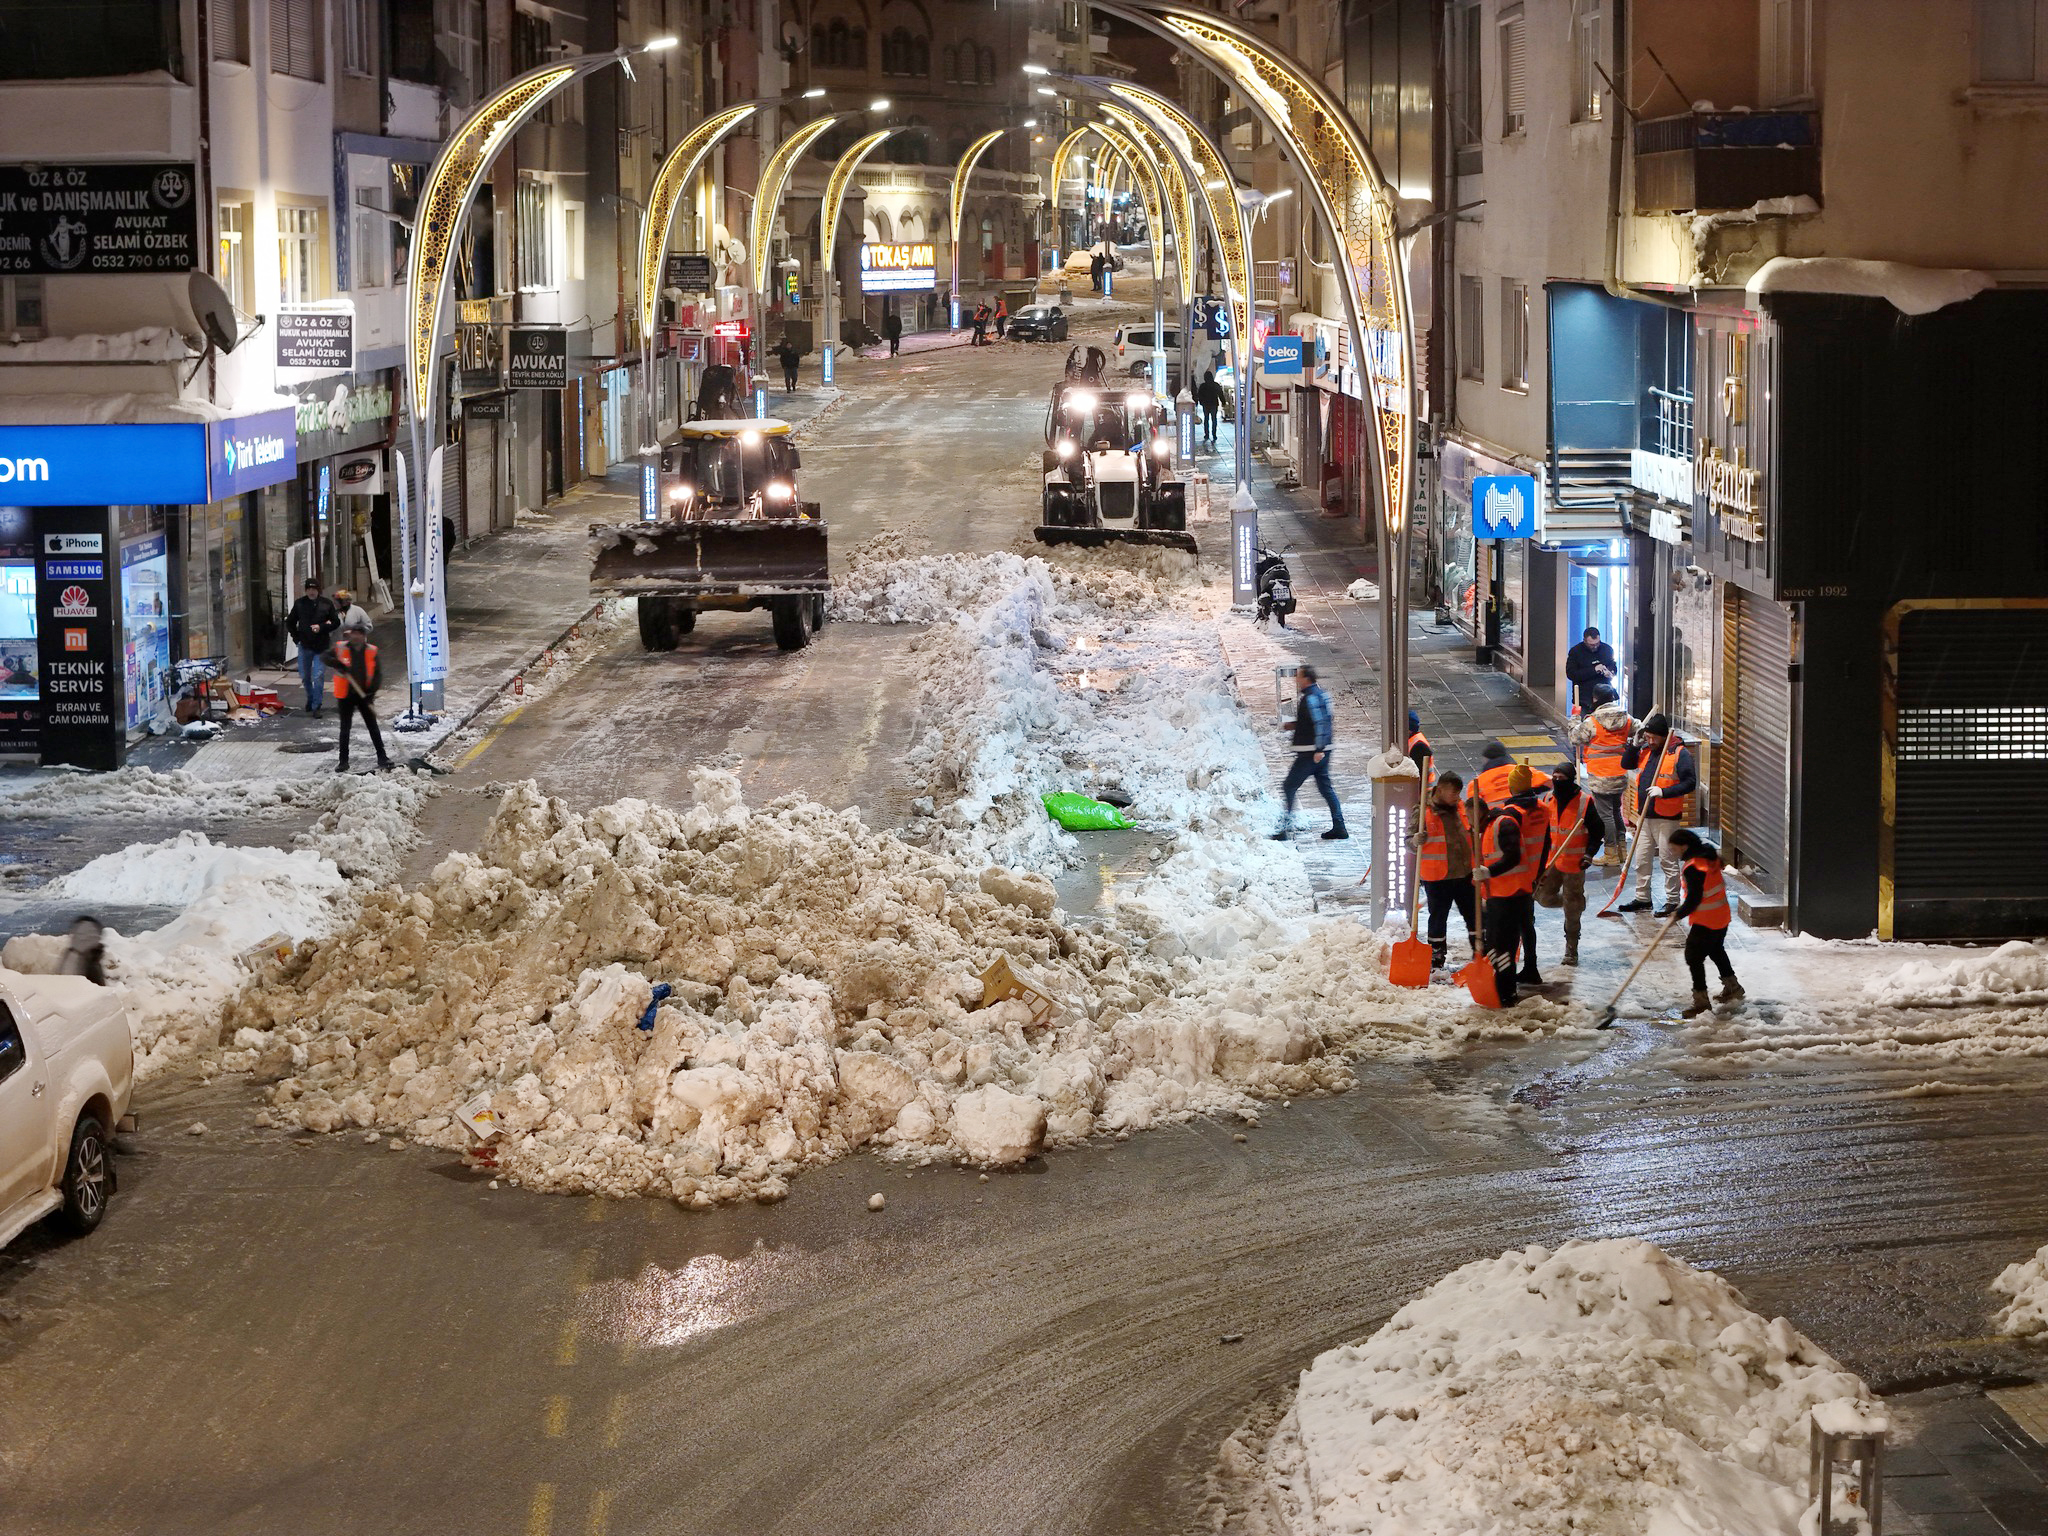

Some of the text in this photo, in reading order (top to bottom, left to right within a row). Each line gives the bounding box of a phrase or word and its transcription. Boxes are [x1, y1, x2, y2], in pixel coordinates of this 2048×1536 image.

[53, 172, 64, 187] &
[67, 168, 87, 187] ÖZ
[21, 196, 37, 212] ve
[43, 189, 150, 217] DANIŞMANLIK
[115, 216, 168, 229] AVUKAT
[0, 230, 188, 252] DEMİR SELAMİ ÖZBEK
[15, 256, 31, 269] 66
[92, 254, 189, 268] 0532 790 61 10
[294, 317, 333, 327] ÖZ & ÖZ
[280, 329, 300, 337] HUKUK
[308, 329, 349, 339] DANIŞMANLIK
[296, 338, 335, 347] AVUKAT
[282, 347, 347, 357] SELAMİ ÖZBEK
[1268, 346, 1299, 357] beko
[511, 355, 565, 370] AVUKAT
[512, 370, 565, 379] TEVFİK ENES KÖKLÜ
[1695, 437, 1756, 517] doğanlar
[65, 538, 99, 548] iPhone
[48, 565, 102, 576] SAMSUNG
[1783, 586, 1848, 597] since 1992
[56, 608, 95, 616] HUAWEI
[49, 658, 105, 675] TEKNİK
[50, 676, 104, 693] SERVİS
[56, 703, 101, 712] EKRAN VE
[49, 715, 67, 724] CAM
[68, 715, 109, 724] ONARIM
